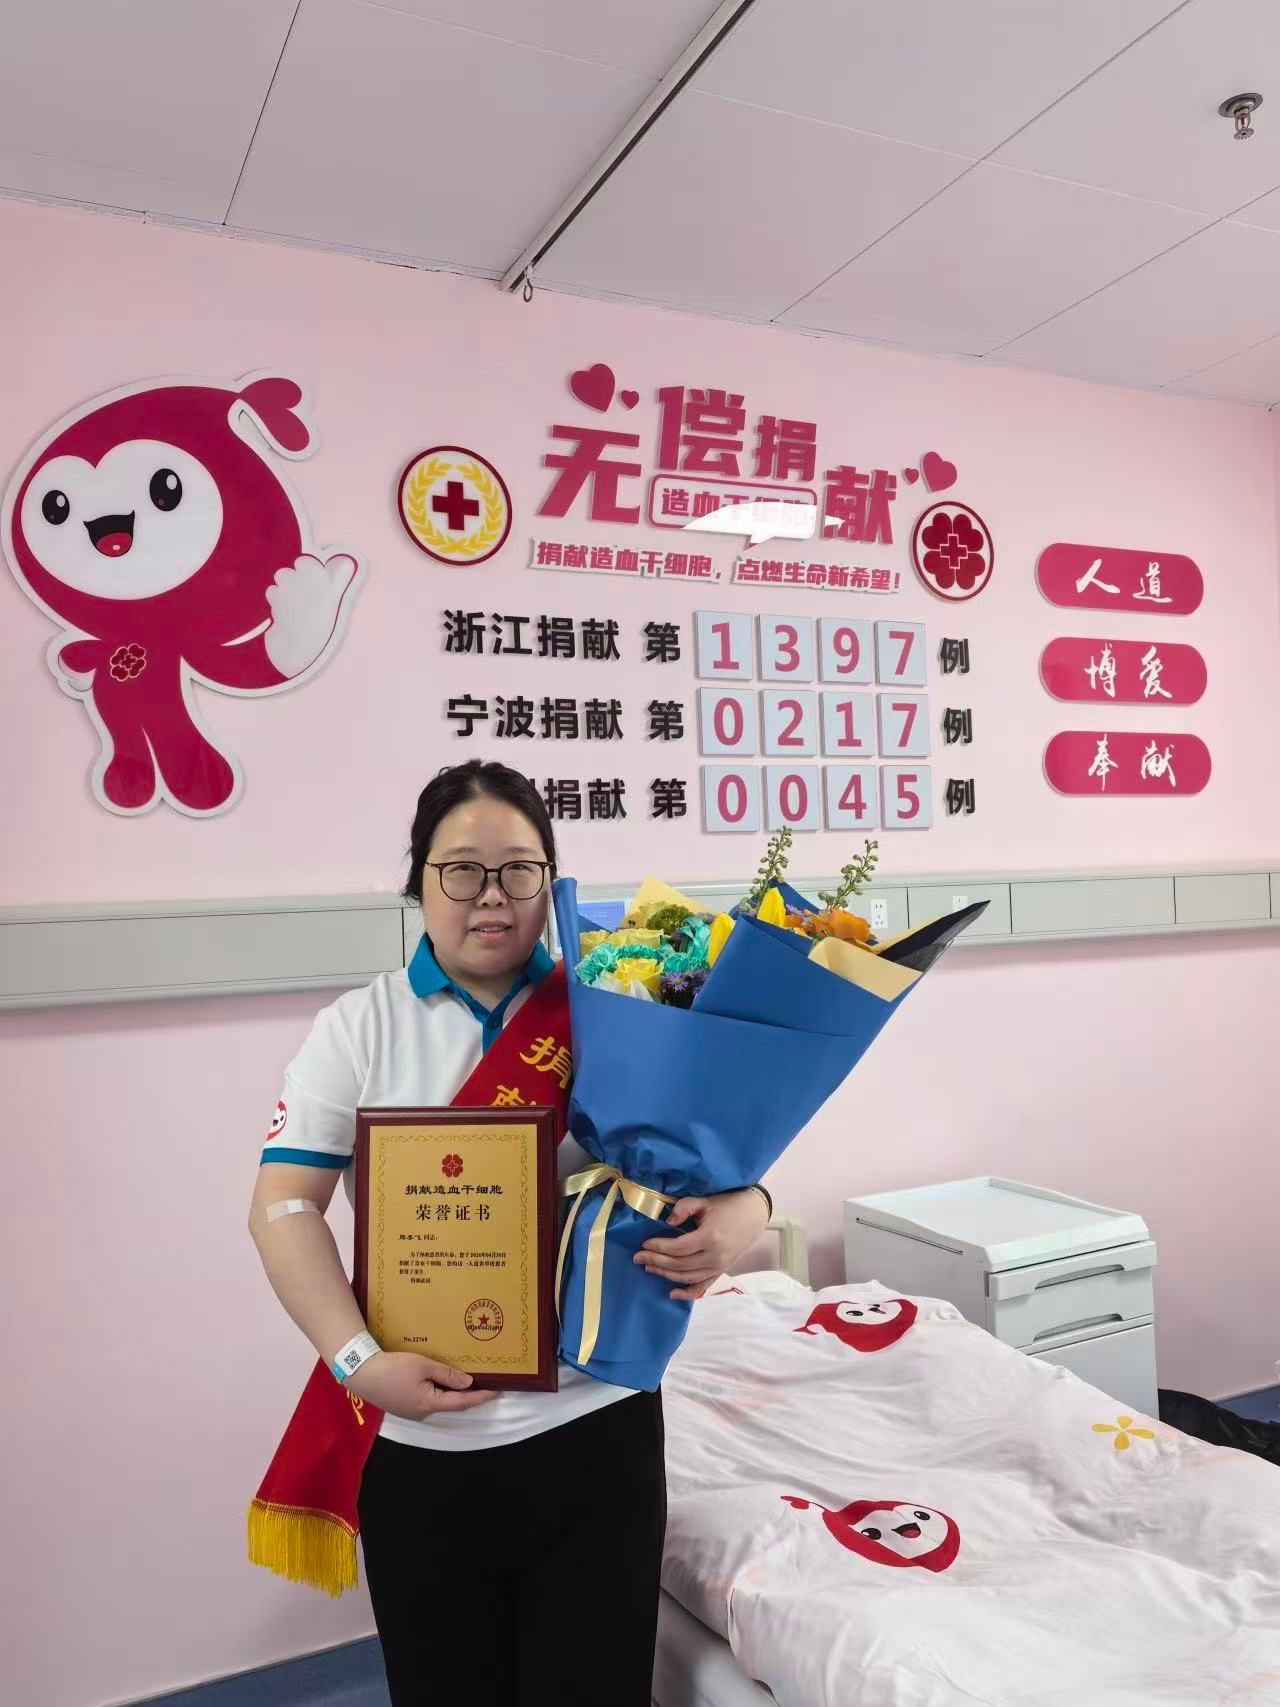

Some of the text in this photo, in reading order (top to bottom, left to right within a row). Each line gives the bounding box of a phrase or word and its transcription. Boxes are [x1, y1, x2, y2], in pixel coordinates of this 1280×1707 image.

[1076, 558, 1173, 604] 人道
[441, 609, 971, 676] 浙江捐献 第 1397 例
[1084, 642, 1173, 699] 博爱
[446, 693, 973, 748] 宁波捐献 第 0217 例
[1087, 733, 1177, 791] 奉献
[530, 774, 976, 824] 捐献 第 0045 例
[405, 1184, 504, 1195] 捐献造血干细胞
[415, 1204, 491, 1222] 荣誉证书
